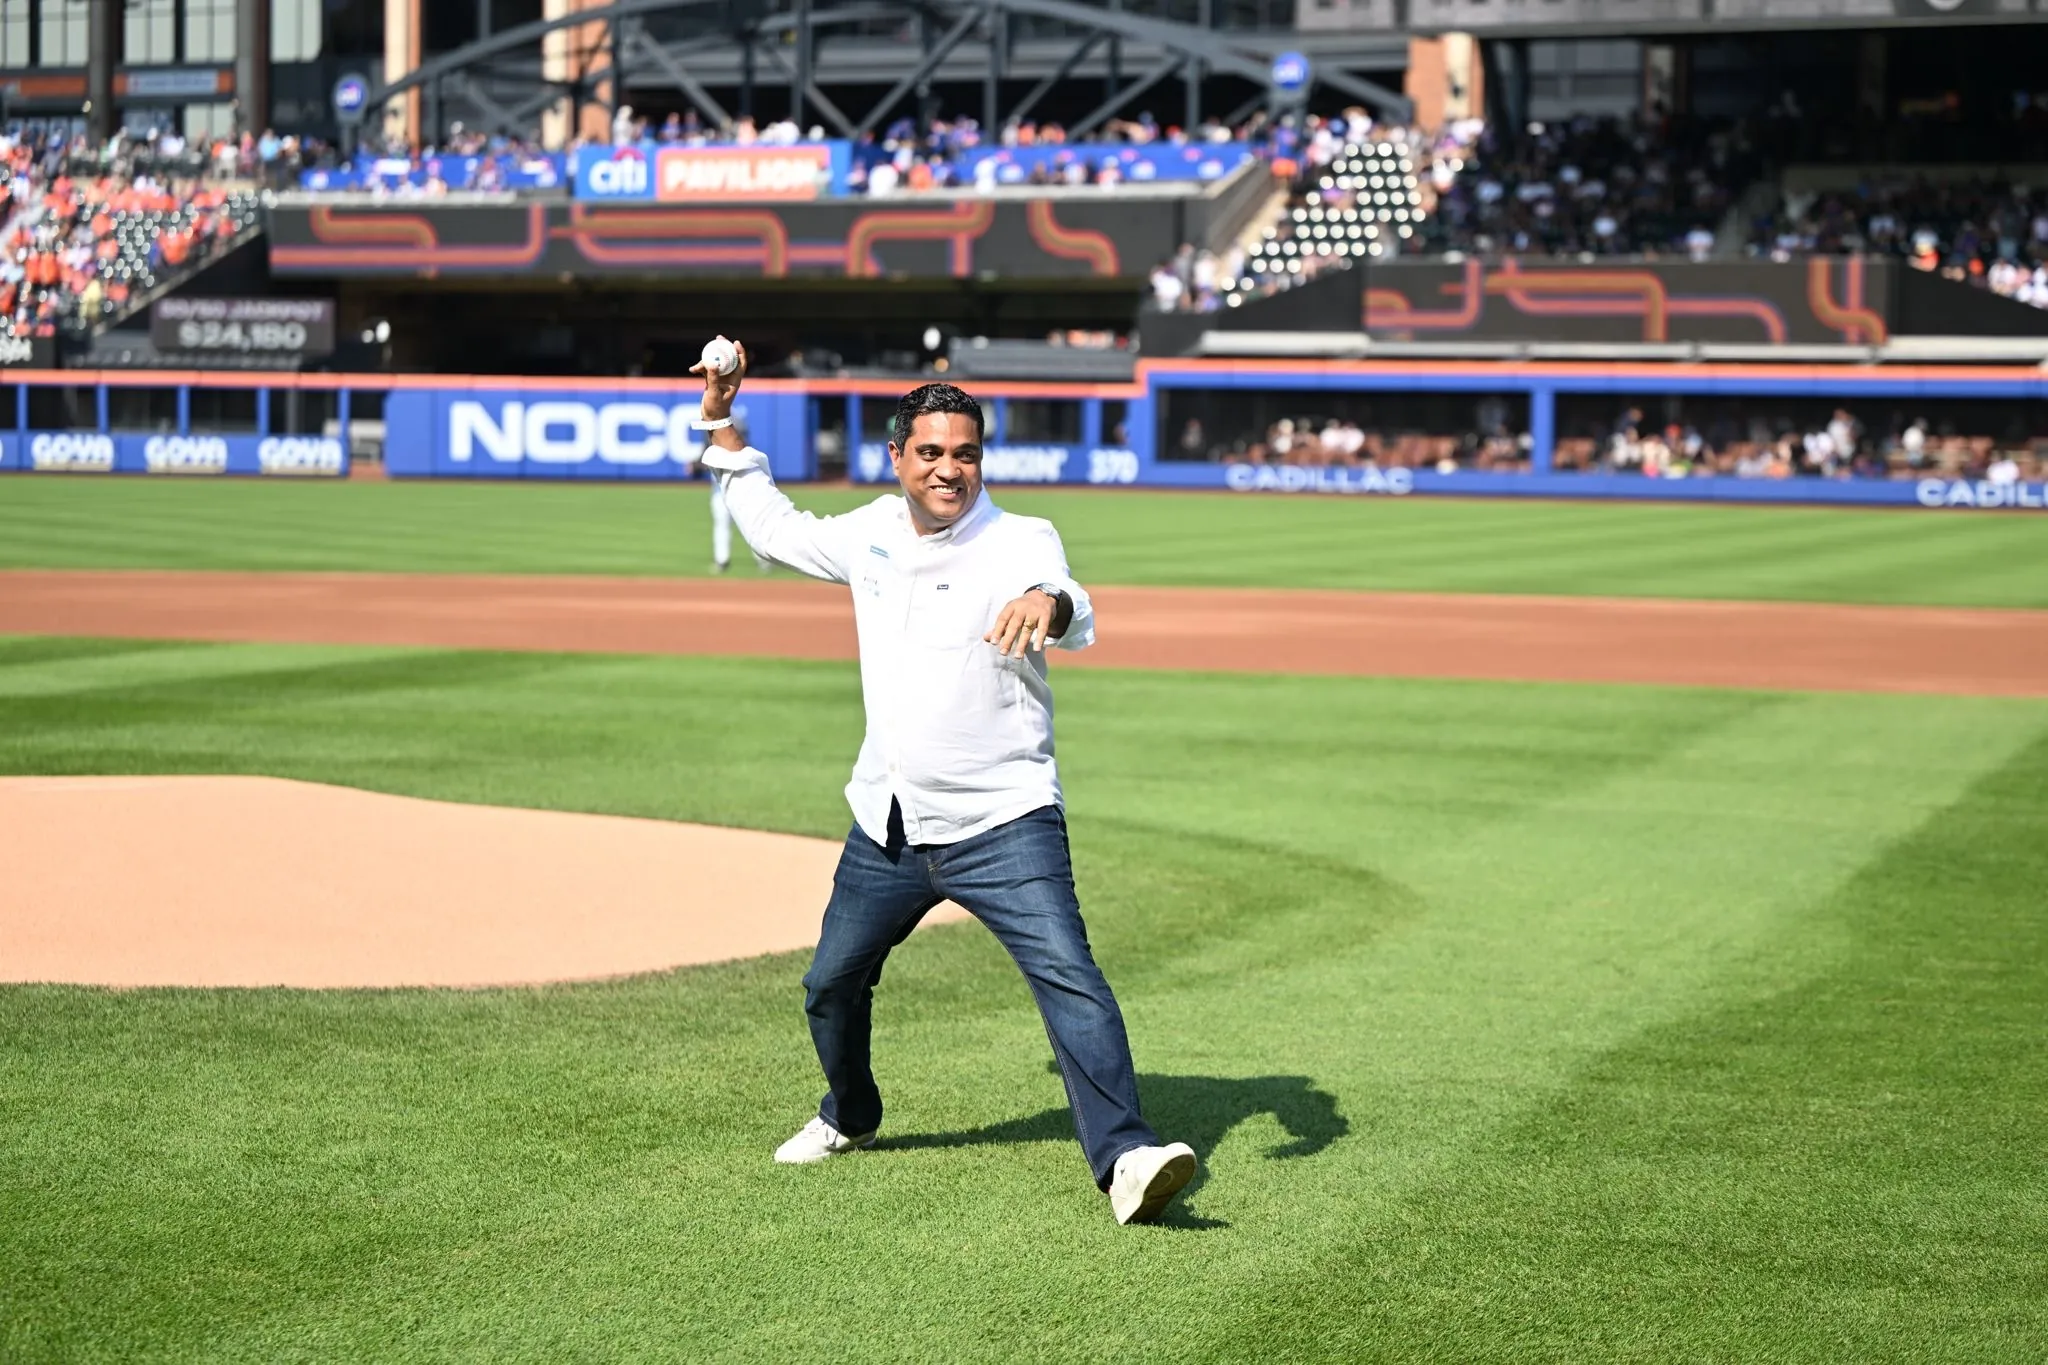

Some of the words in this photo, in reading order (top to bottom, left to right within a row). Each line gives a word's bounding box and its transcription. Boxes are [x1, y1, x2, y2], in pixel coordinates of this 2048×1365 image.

[589, 156, 647, 195] citi
[664, 158, 818, 193] PAVILION
[1225, 463, 1414, 494] CADILLAC
[1916, 478, 2048, 507] CADIL
